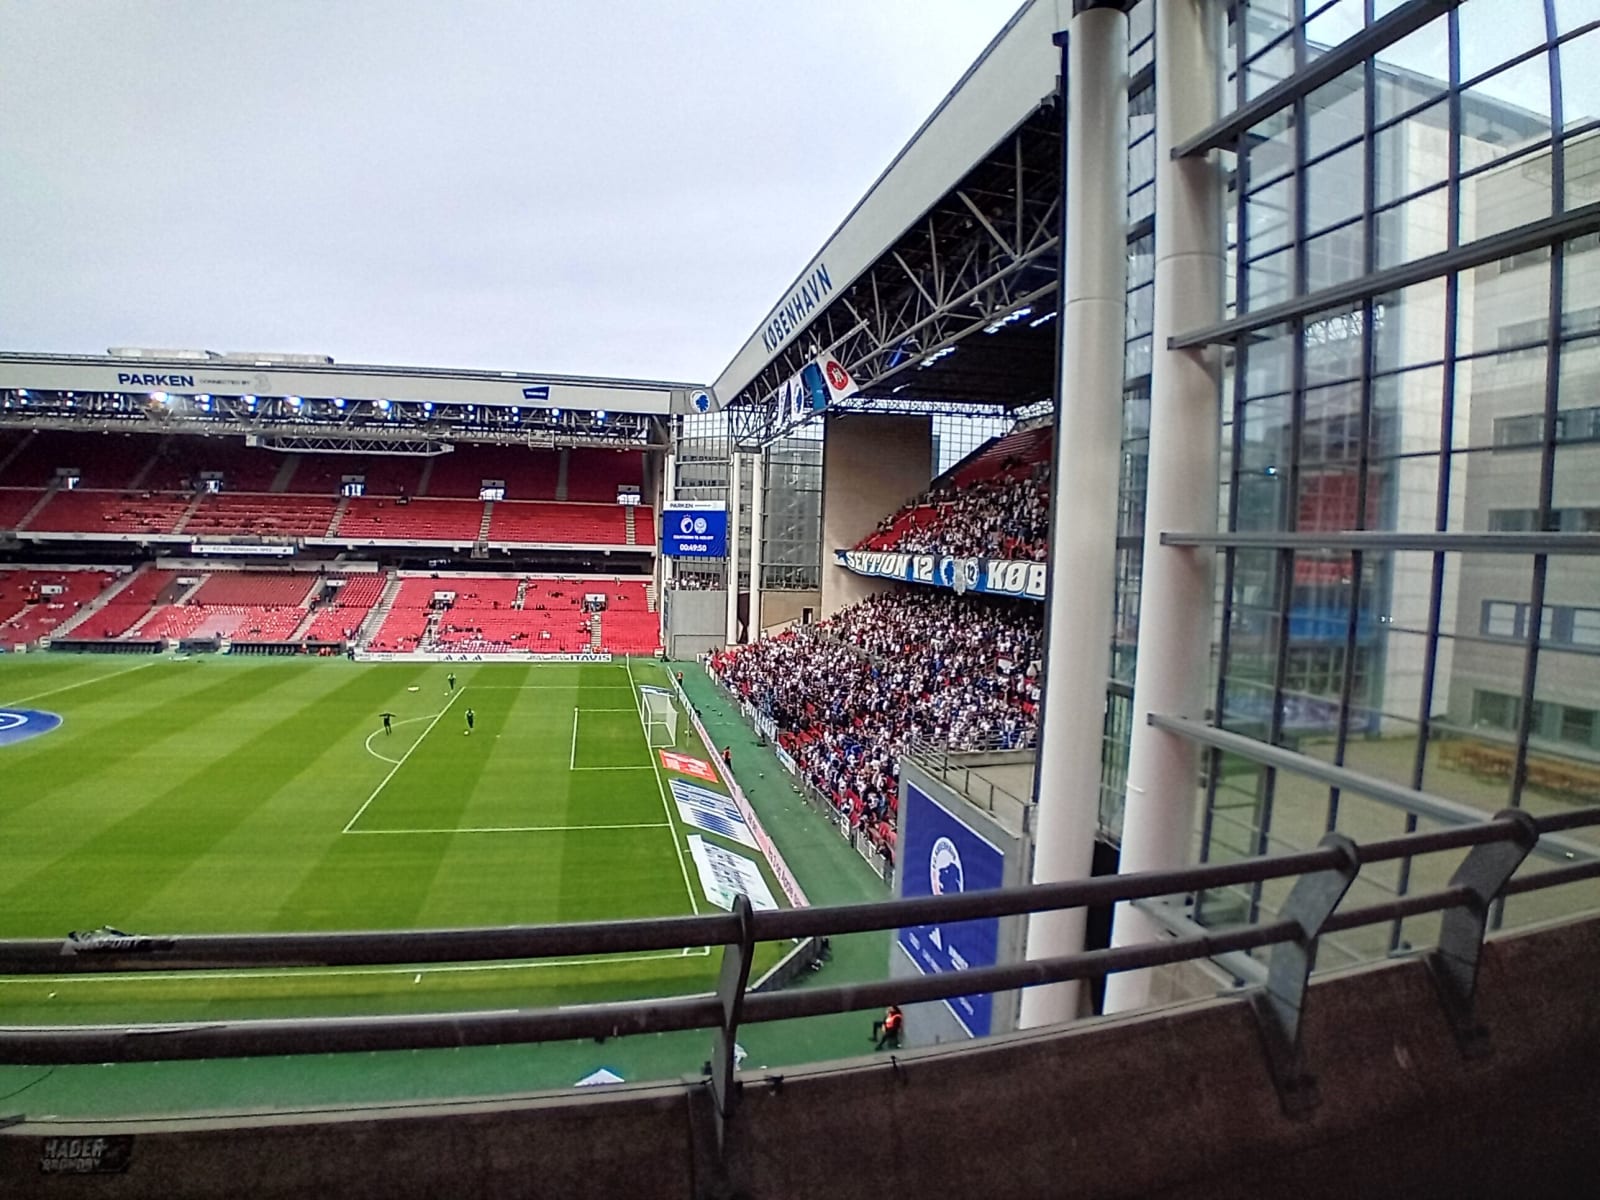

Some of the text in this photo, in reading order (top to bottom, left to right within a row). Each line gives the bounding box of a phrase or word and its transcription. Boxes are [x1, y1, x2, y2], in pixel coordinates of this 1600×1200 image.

[761, 263, 833, 354] KØBENHAVN
[118, 373, 194, 387] PARKEN
[846, 551, 912, 579] SEKTION
[912, 555, 935, 582] 12
